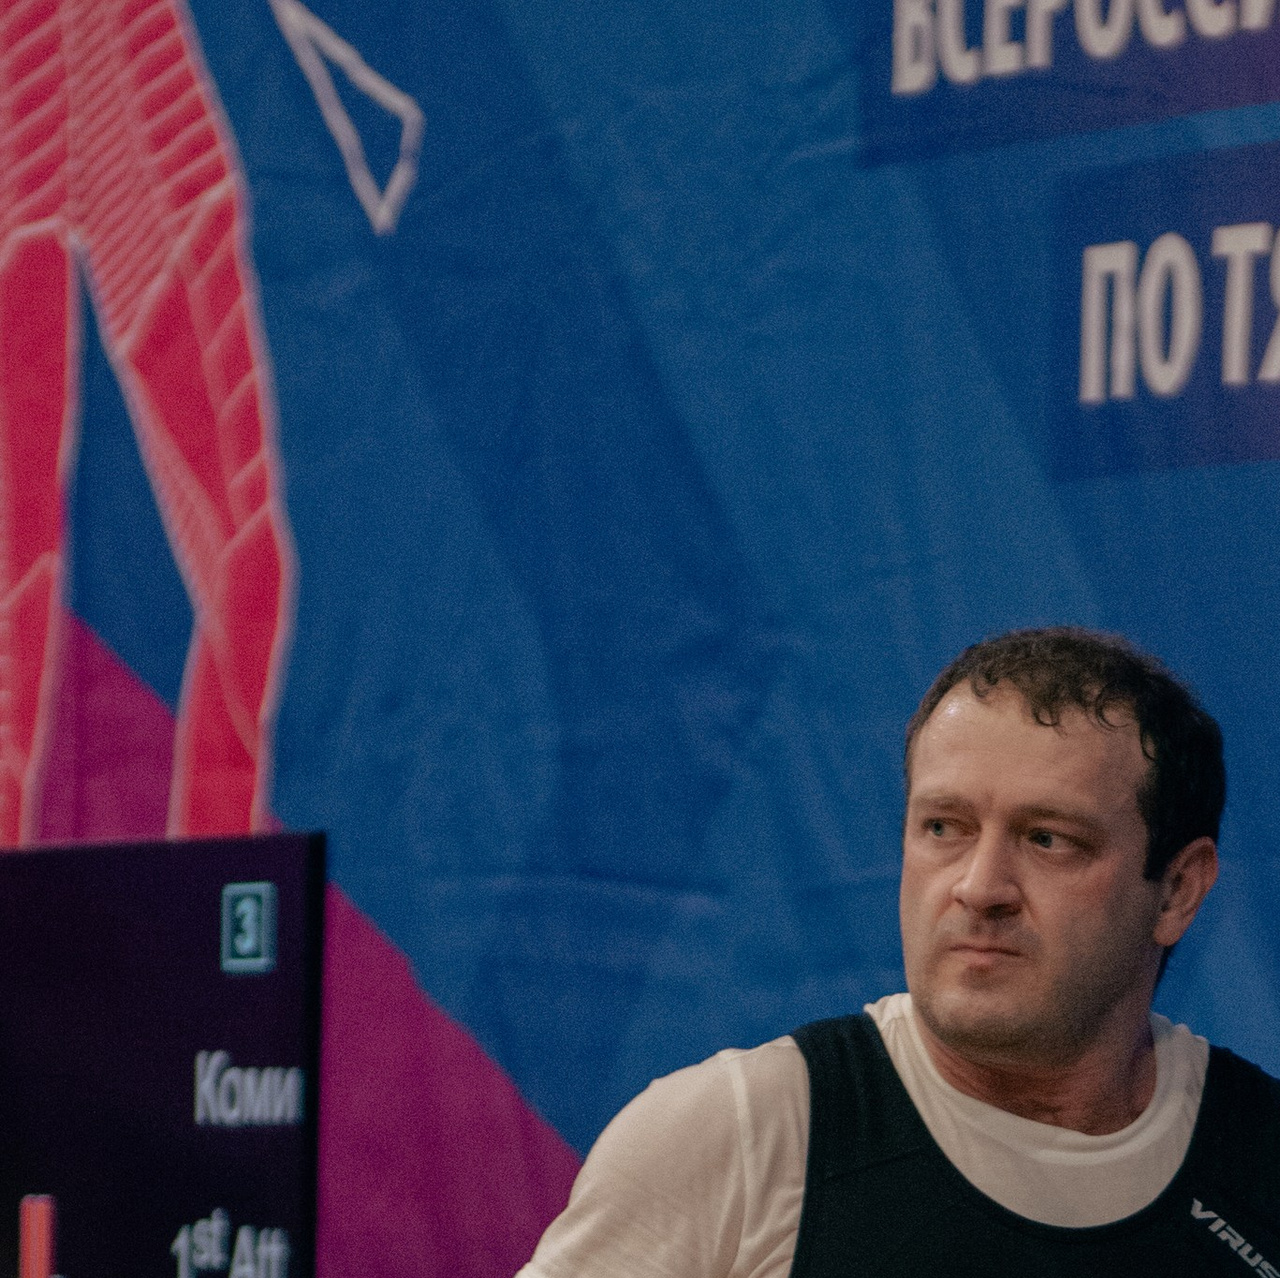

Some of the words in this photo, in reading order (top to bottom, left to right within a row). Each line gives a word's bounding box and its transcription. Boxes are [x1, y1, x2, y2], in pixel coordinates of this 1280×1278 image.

[1080, 233, 1200, 404] ПО
[235, 897, 258, 954] 3
[195, 1051, 302, 1126] Коми
